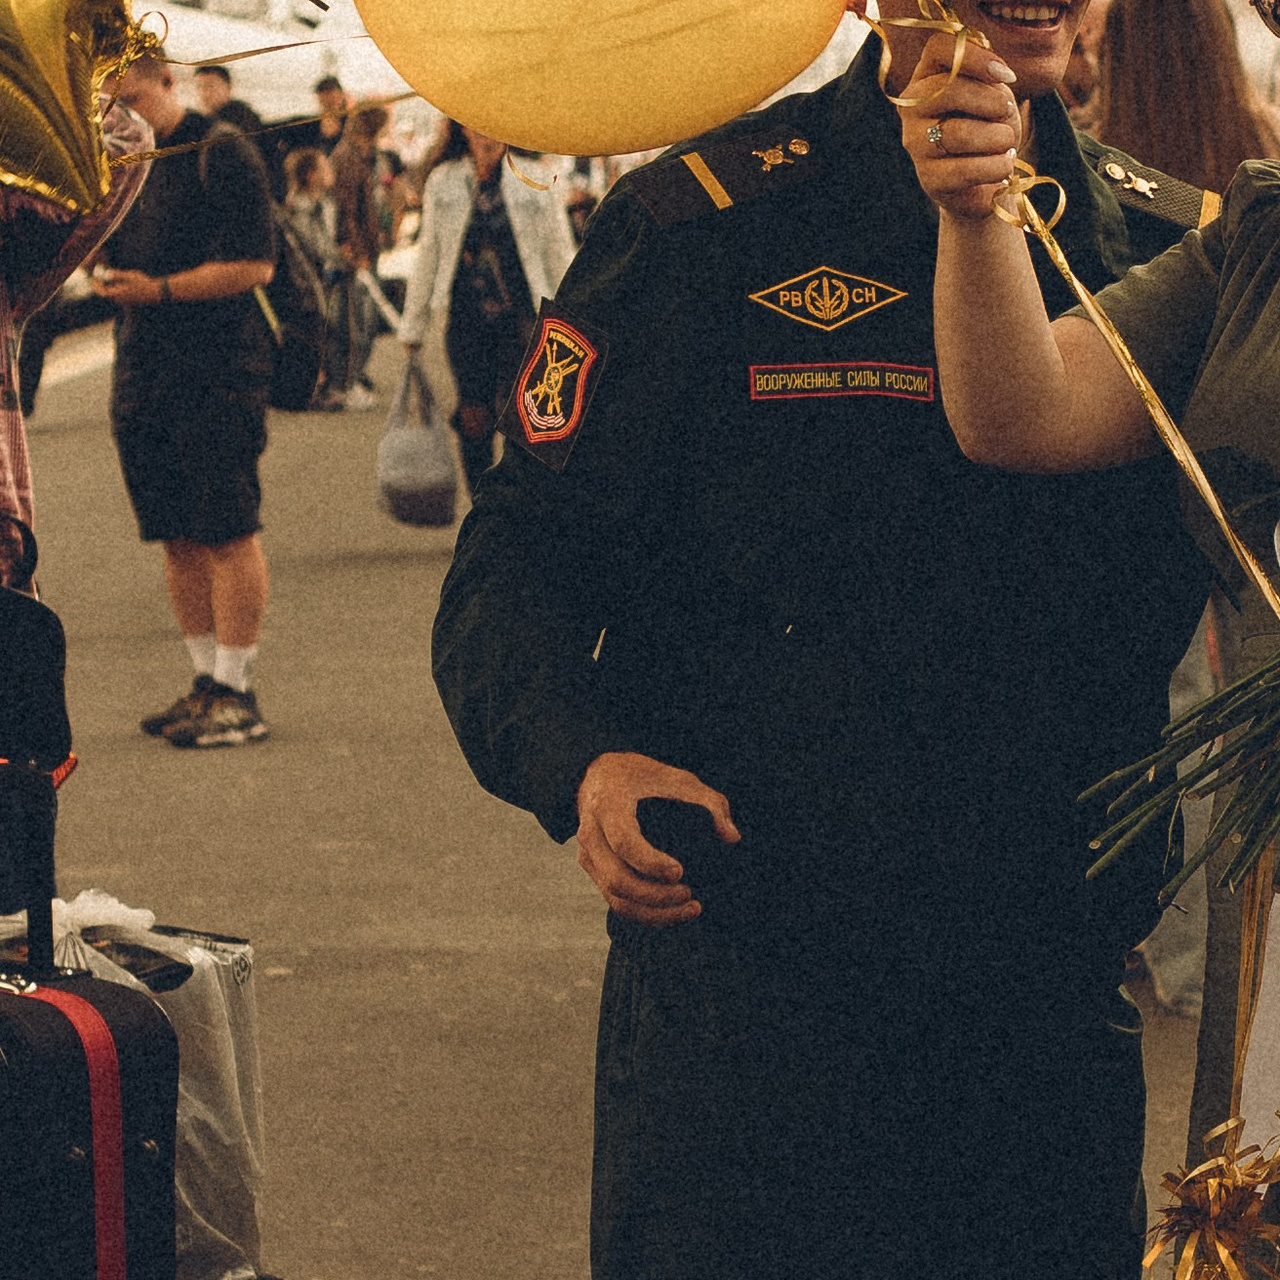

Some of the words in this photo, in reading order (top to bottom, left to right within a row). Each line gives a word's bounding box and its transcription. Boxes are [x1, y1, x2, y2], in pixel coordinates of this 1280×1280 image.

[779, 290, 803, 307] РВ
[851, 286, 876, 304] СН
[755, 371, 843, 391] ВООРУЖЕННЫЕ
[847, 370, 880, 387] СИЛЫ
[885, 371, 928, 392] РОССИИ
